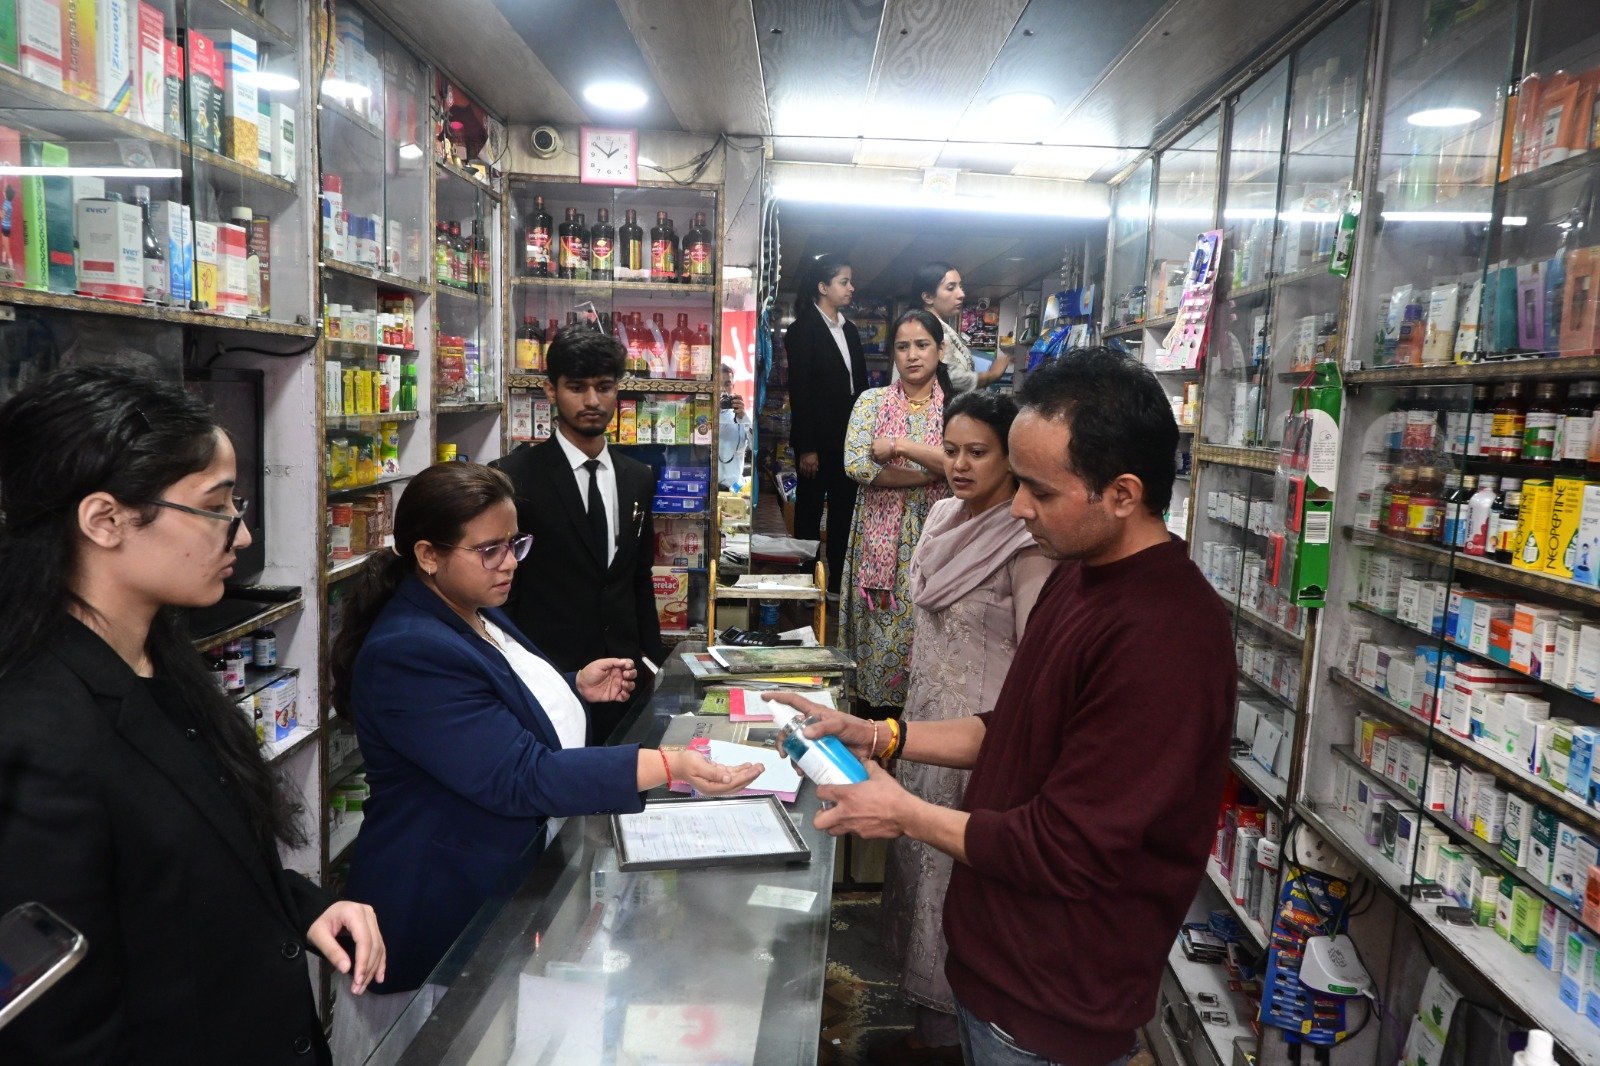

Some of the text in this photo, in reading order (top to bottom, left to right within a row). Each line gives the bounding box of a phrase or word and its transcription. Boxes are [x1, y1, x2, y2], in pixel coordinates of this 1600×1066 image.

[1545, 485, 1567, 570] NEOPEPTINE
[653, 581, 677, 589] erelac
[1508, 801, 1522, 816] EYE
[1561, 830, 1578, 845] EY
